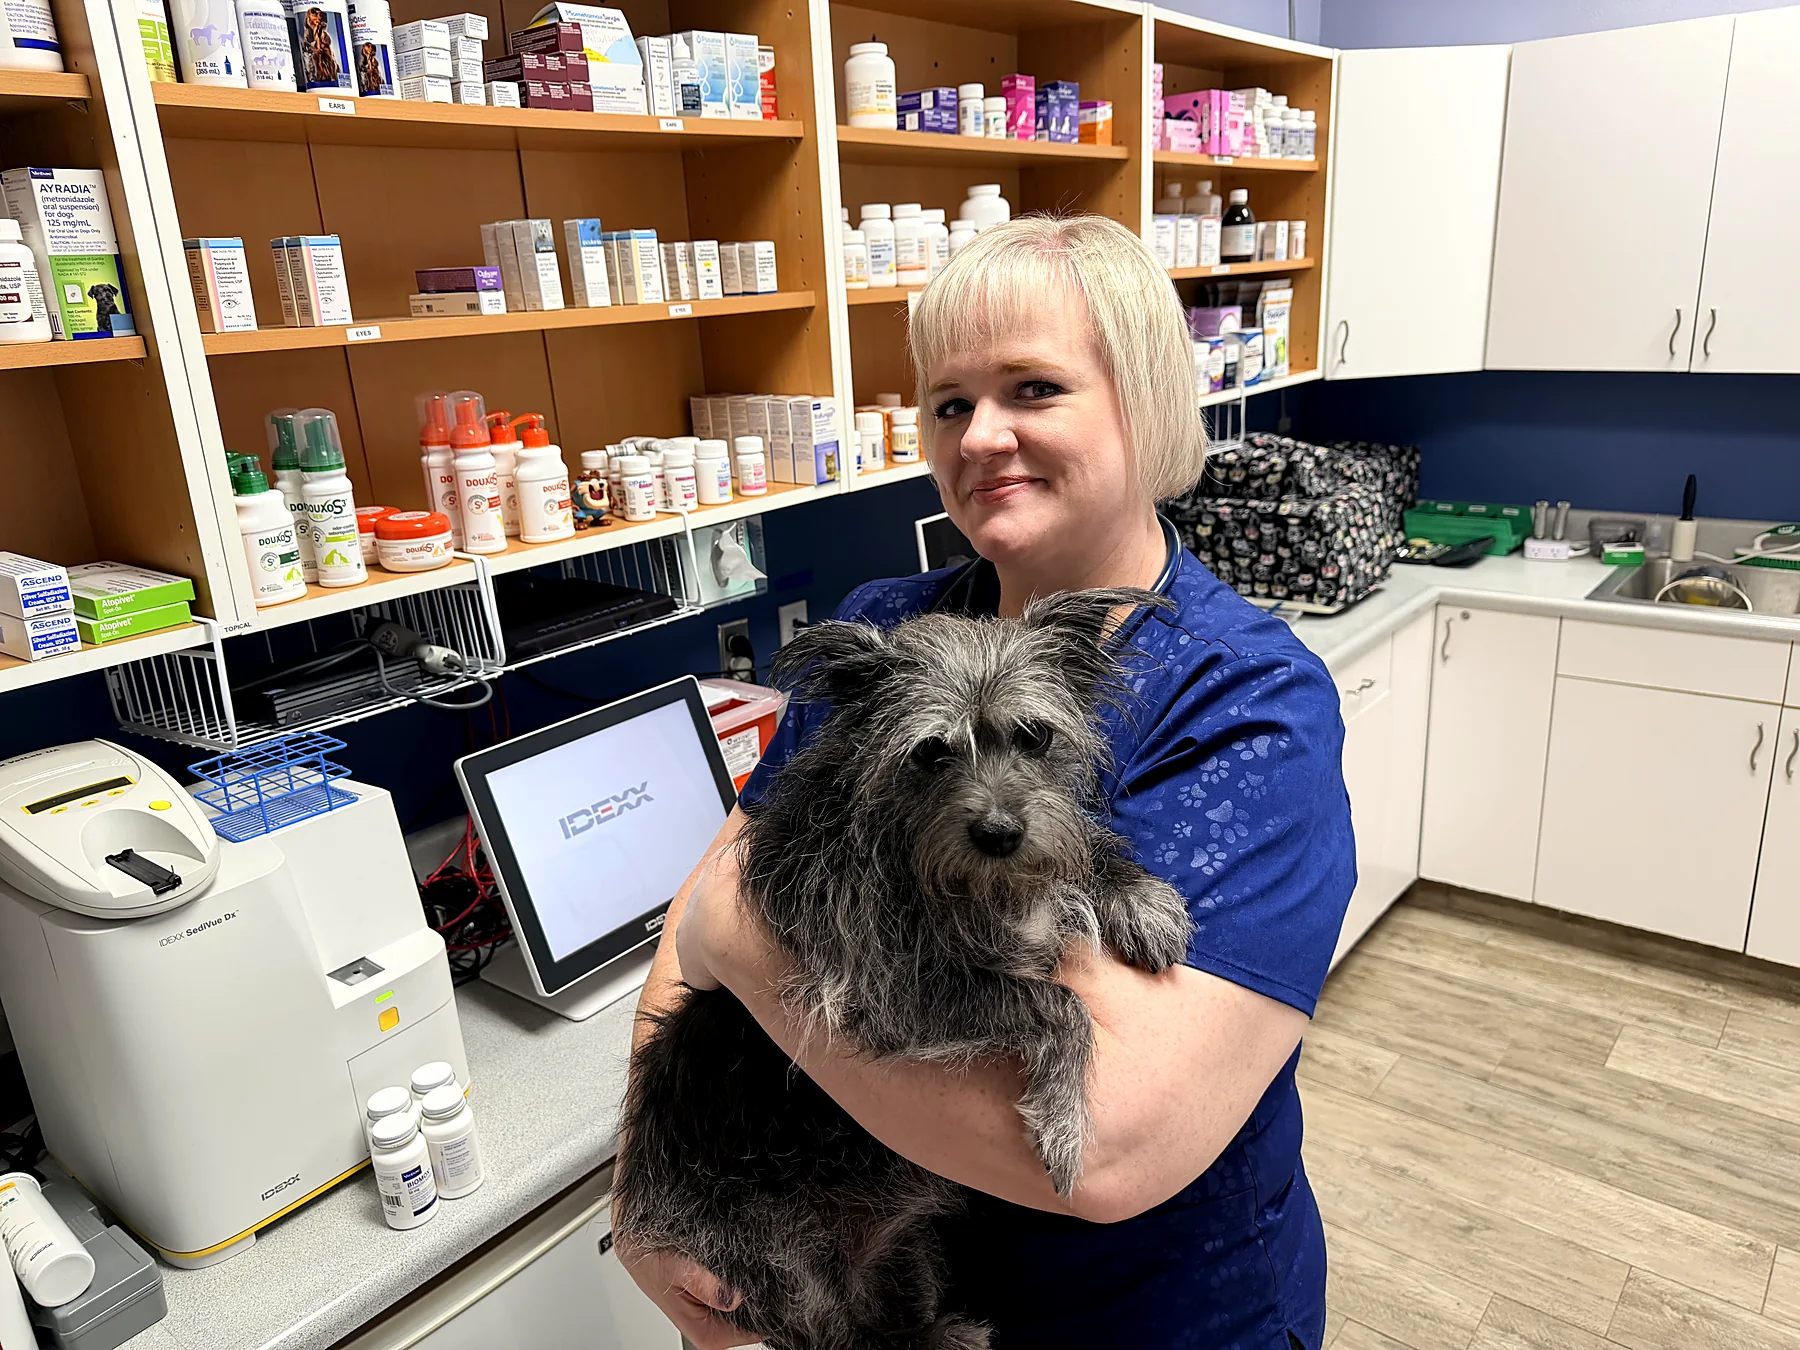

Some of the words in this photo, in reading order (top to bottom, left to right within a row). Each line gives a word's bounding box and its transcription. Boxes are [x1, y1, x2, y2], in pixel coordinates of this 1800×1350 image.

[42, 195, 95, 203] (metronidazole
[62, 220, 91, 228] mg/mL
[21, 575, 62, 587] ASCEND
[31, 617, 70, 630] ASCEND
[224, 622, 252, 632] TOPICAL
[558, 781, 654, 840] IDEXX
[645, 913, 666, 932] IDE
[159, 932, 184, 947] IDEXX
[186, 918, 222, 936] SediVue
[261, 1173, 300, 1201] IDEXX
